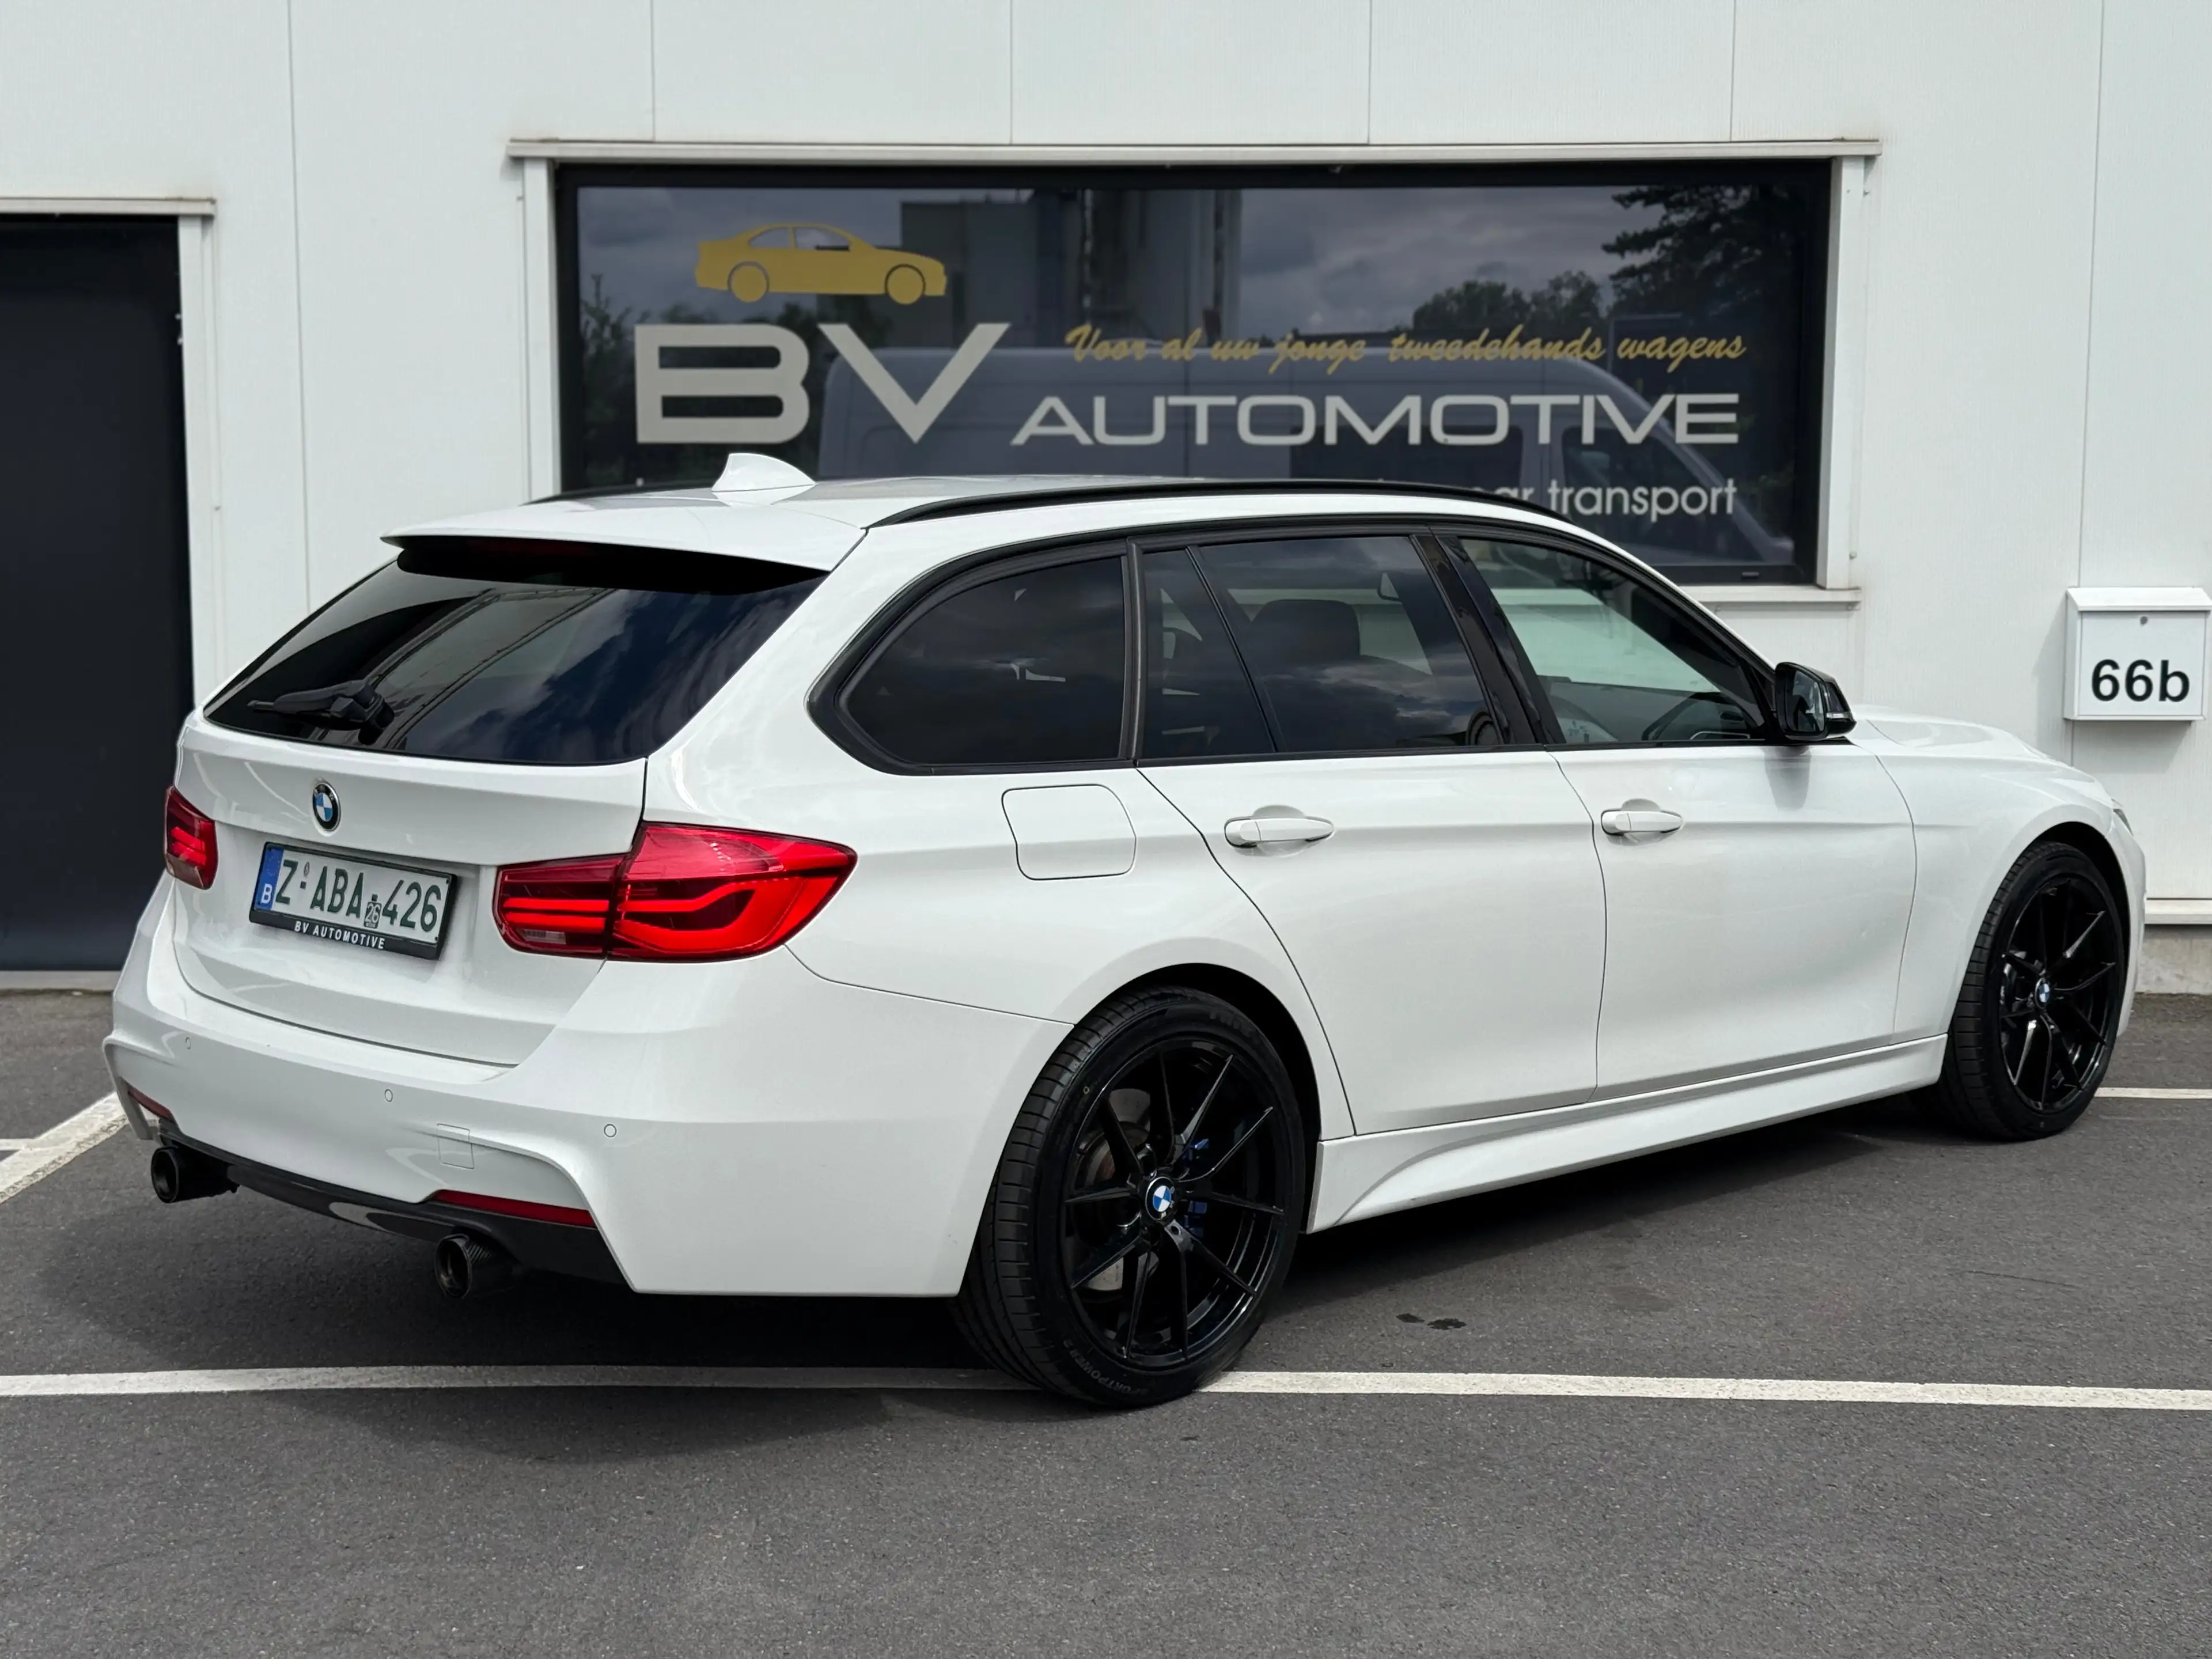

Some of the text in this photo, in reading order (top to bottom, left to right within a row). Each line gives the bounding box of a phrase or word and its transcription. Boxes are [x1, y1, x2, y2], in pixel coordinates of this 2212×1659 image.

[1065, 321, 1747, 376] Voor al uw jonge tweedehands wagens
[635, 322, 1739, 446] BV AUTOMOTIVE
[1547, 479, 1737, 521] transport
[2090, 658, 2190, 703] 66b
[261, 884, 273, 904] B
[365, 903, 381, 924] 26
[294, 921, 385, 950] BV AUTOMOTIVE
